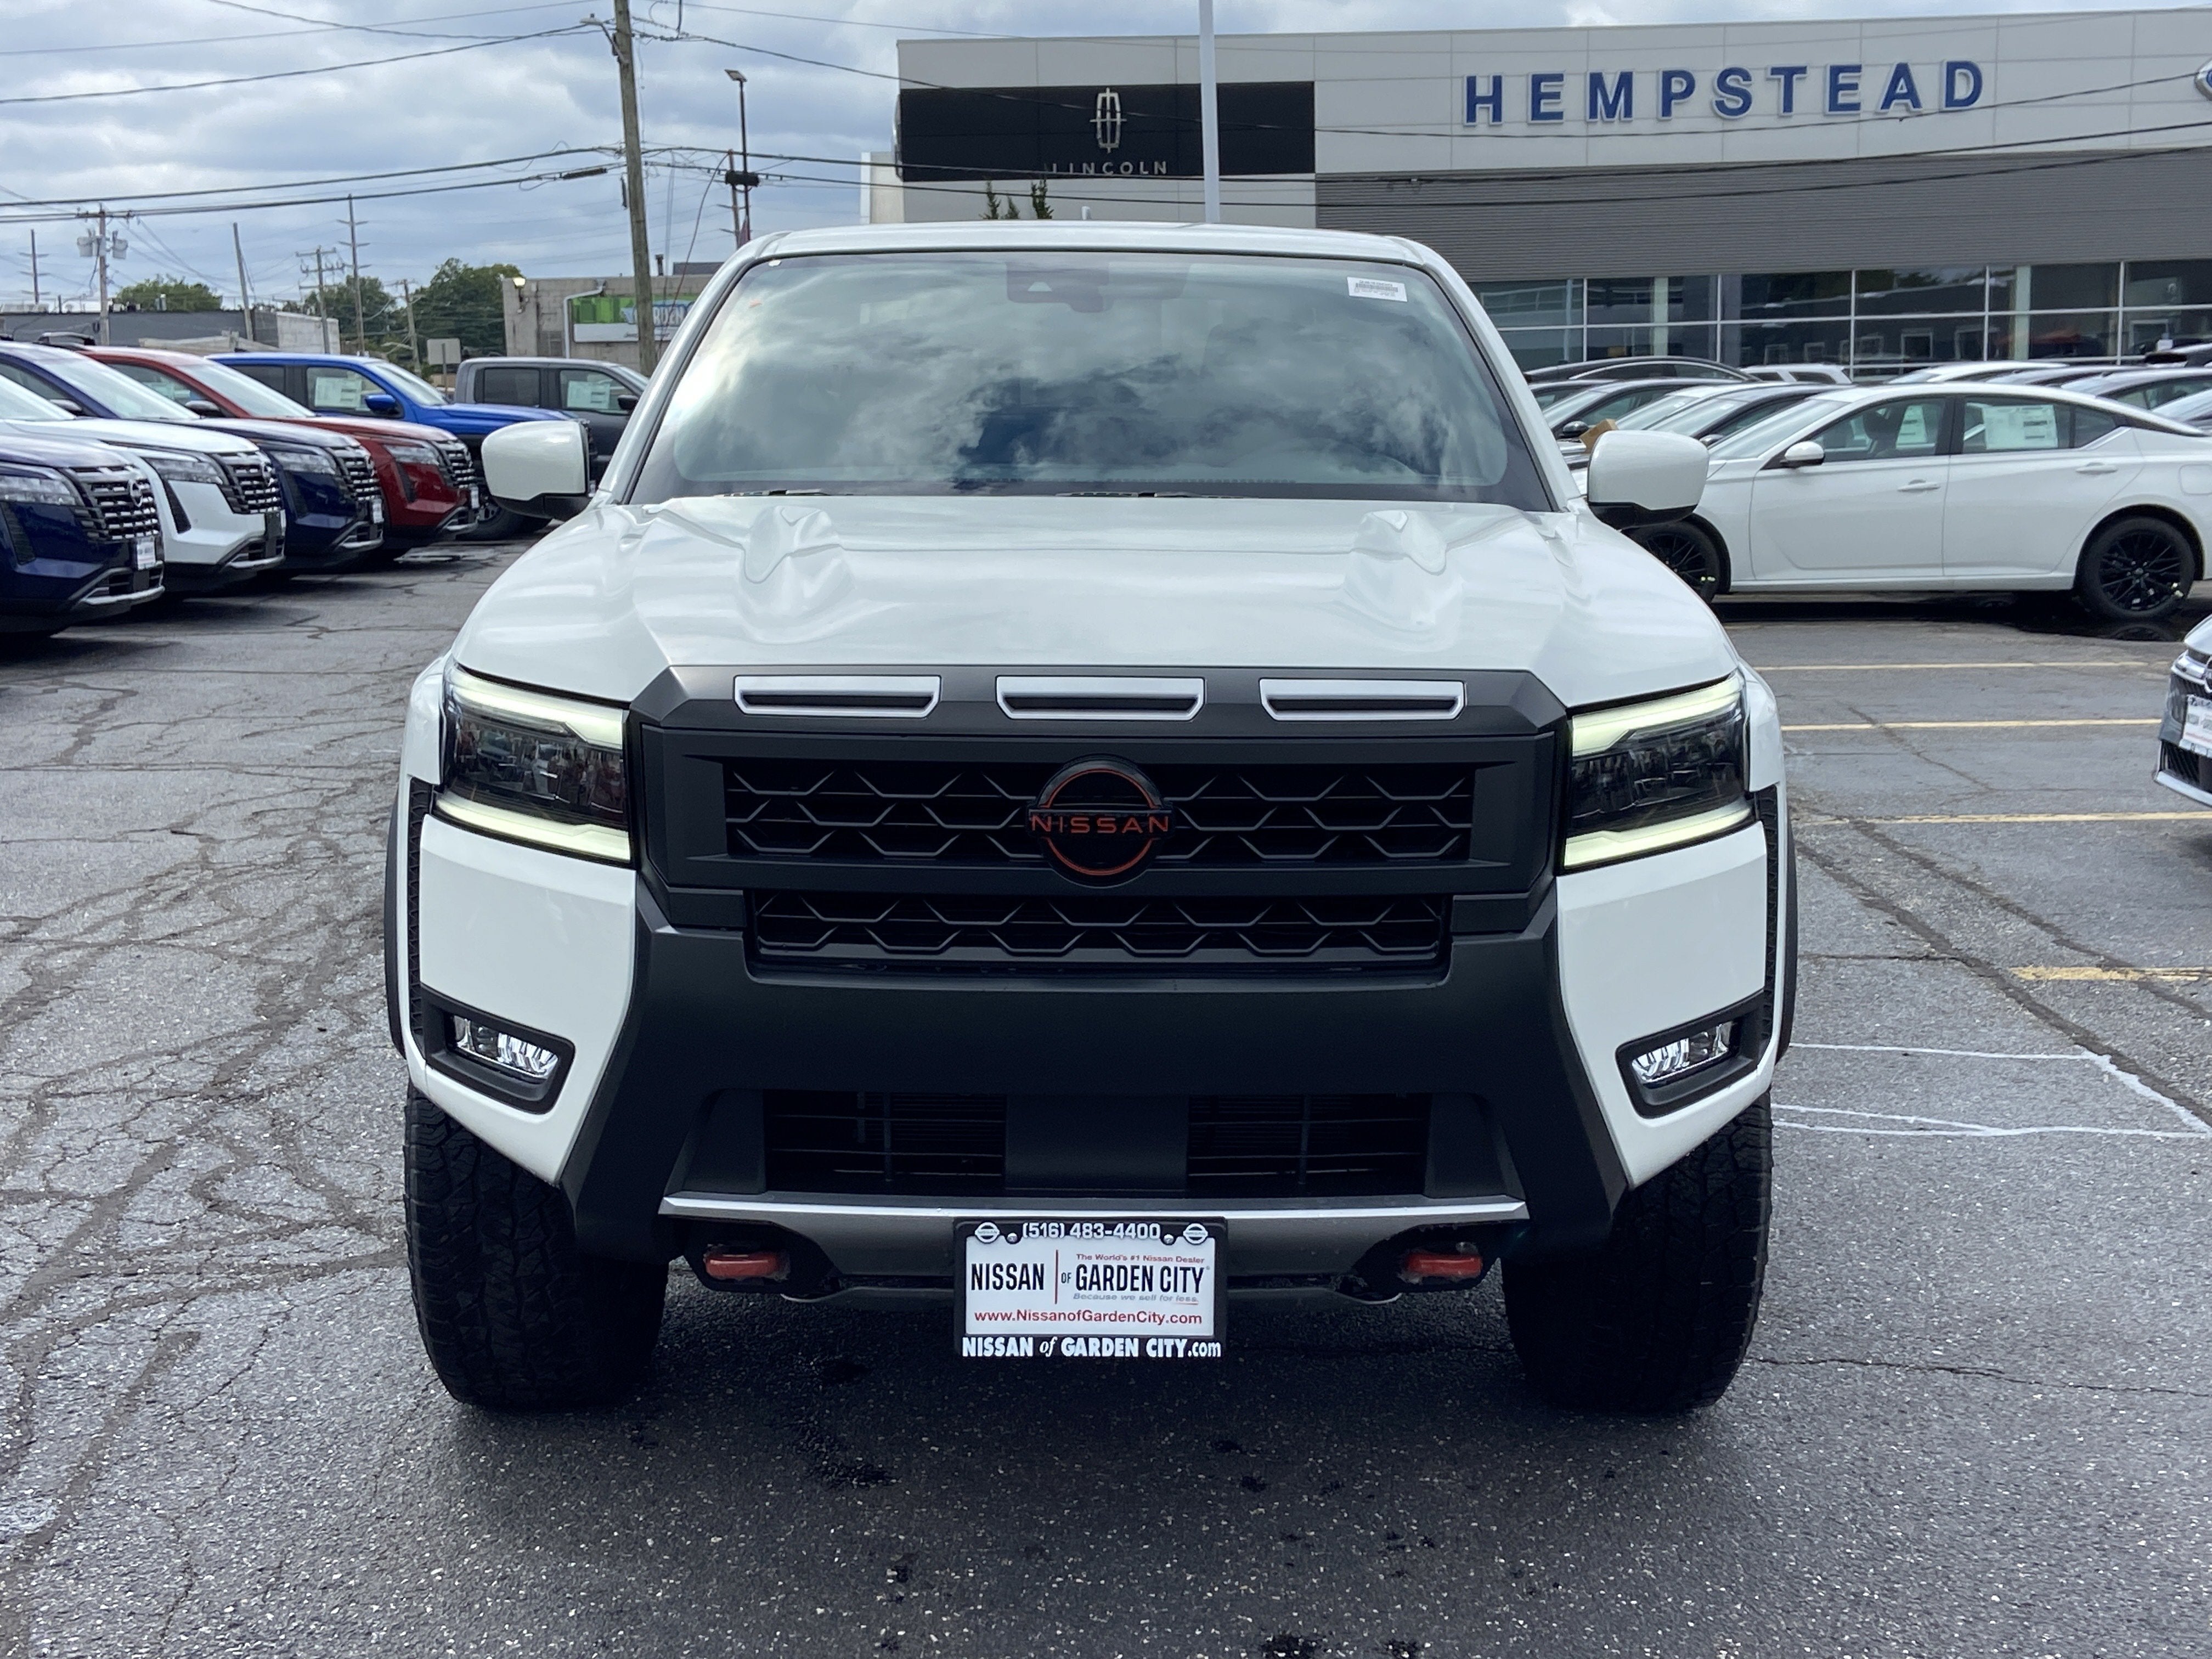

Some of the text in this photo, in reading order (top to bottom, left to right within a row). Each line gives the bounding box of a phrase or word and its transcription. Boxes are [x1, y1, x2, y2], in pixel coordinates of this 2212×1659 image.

[1464, 61, 1984, 125] HEMPSTEAD
[1052, 161, 1167, 175] LINCOLN
[1031, 815, 1169, 834] NISSAN
[1022, 1222, 1161, 1239] (516) 483-4400
[1176, 1256, 1205, 1264] Dealer
[971, 1263, 1205, 1294] NISSAN OF GARDEN CITY
[974, 1309, 1203, 1326] www.NissanofGardenCity.com
[962, 1336, 1222, 1358] NISSAN of GARDEN CITY.com
